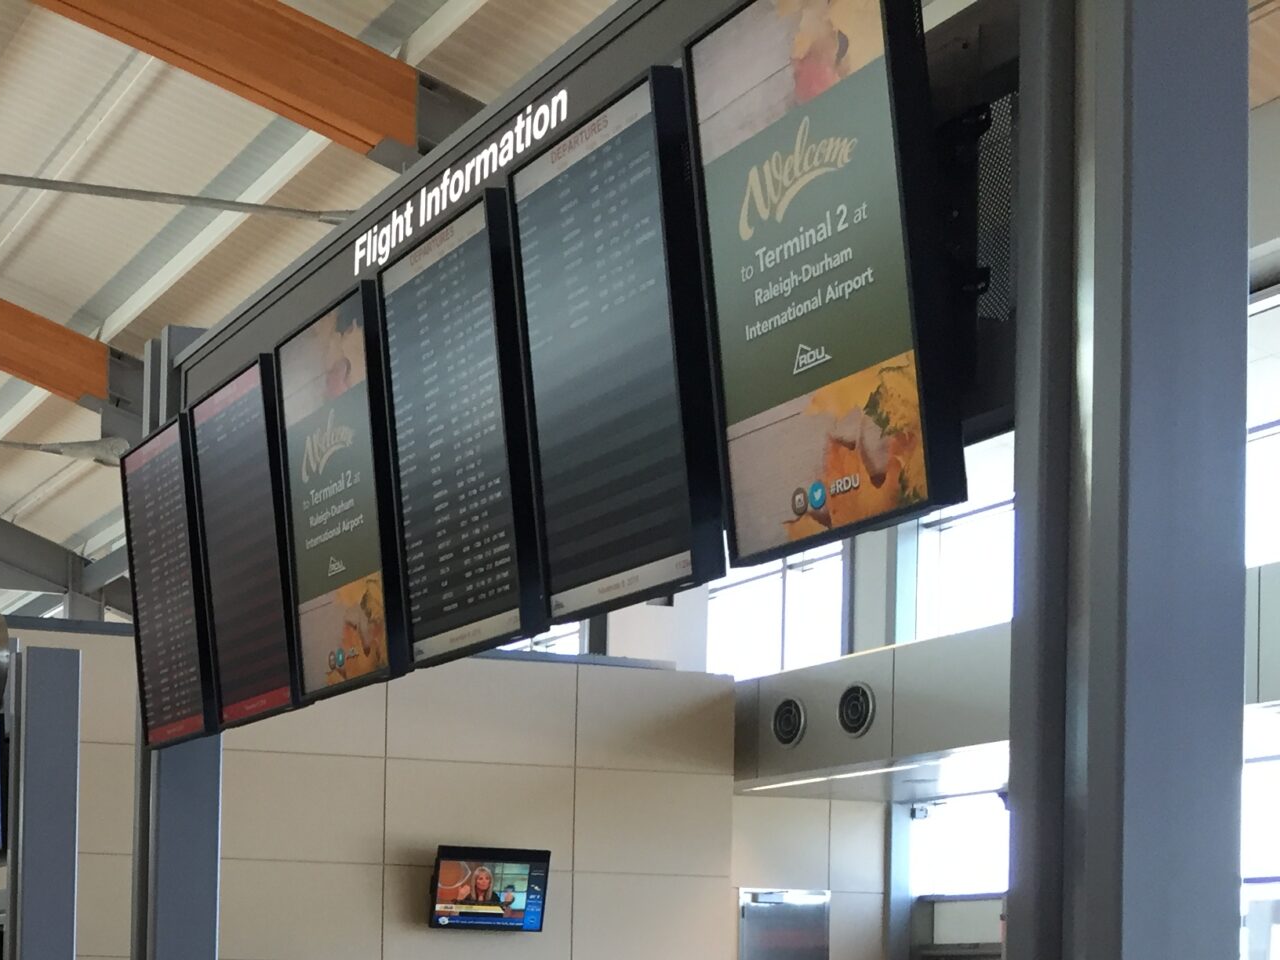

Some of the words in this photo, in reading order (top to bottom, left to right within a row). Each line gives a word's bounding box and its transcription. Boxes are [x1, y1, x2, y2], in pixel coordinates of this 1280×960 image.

[354, 200, 413, 276] Flight
[419, 88, 568, 228] Information
[738, 115, 859, 240] Welcome
[741, 262, 755, 283] to
[755, 210, 832, 272] Terminal
[835, 203, 849, 232] 2
[853, 201, 868, 224] at
[754, 245, 853, 306] Raleigh-Durham
[745, 290, 822, 341] International
[825, 266, 874, 304] Airport
[798, 345, 826, 367] RDU
[309, 474, 346, 506] Terminal
[345, 469, 353, 487] 2
[829, 474, 860, 497] #RDU
[305, 522, 341, 551] International
[341, 514, 364, 538] Airport
[309, 497, 355, 529] Raleigh-Durham
